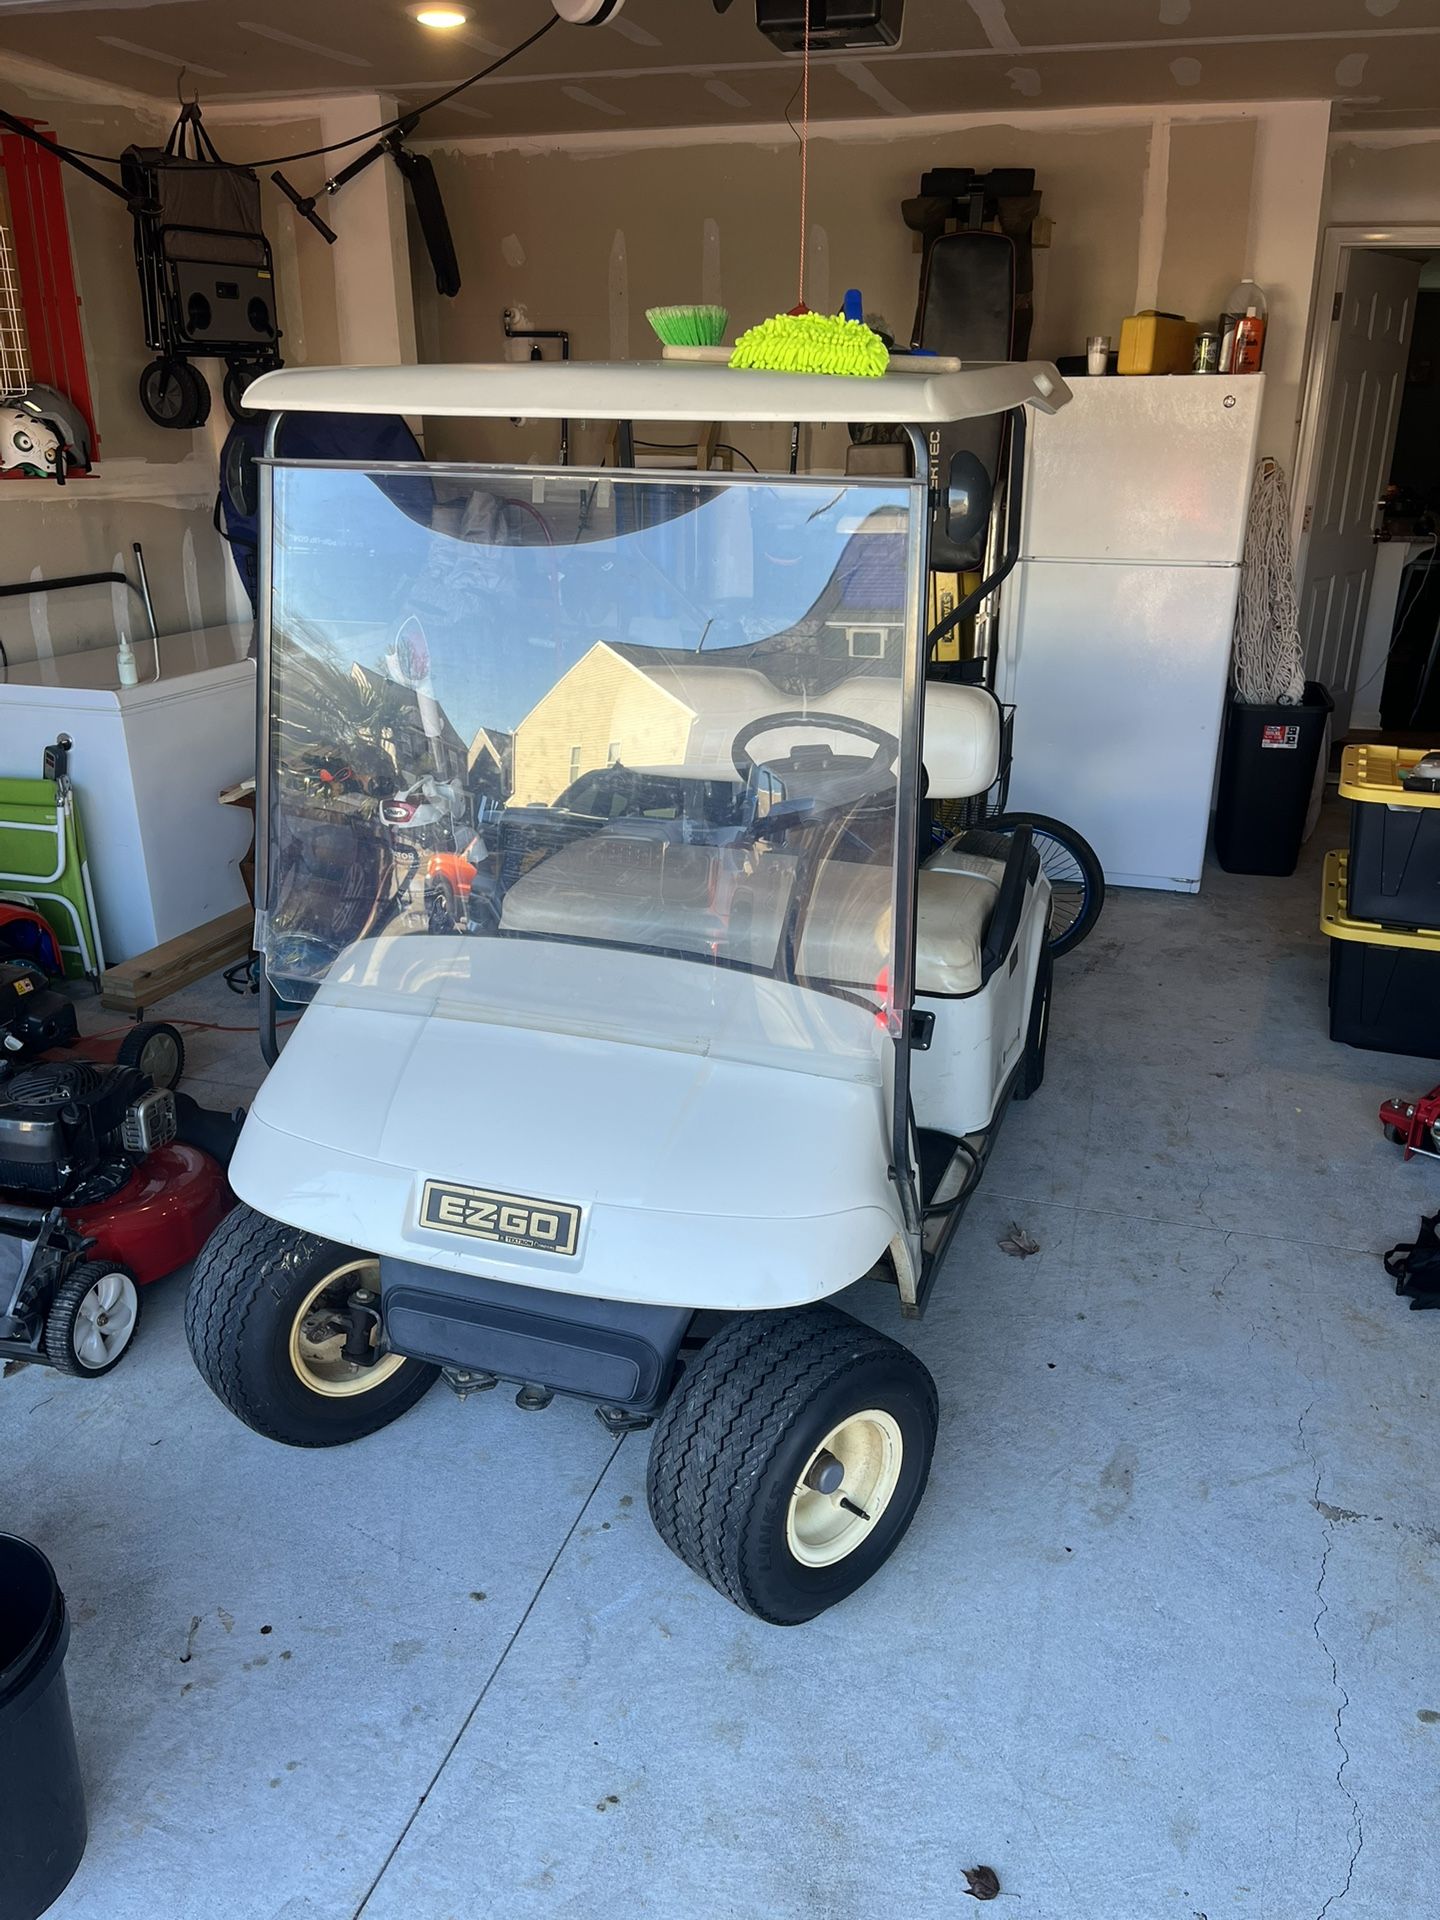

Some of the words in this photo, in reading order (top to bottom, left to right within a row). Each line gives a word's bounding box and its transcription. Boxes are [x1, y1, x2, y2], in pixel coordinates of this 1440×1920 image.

[944, 595, 953, 639] STAY
[438, 1195, 559, 1241] EZGO
[506, 1236, 533, 1247] TEXTRON
